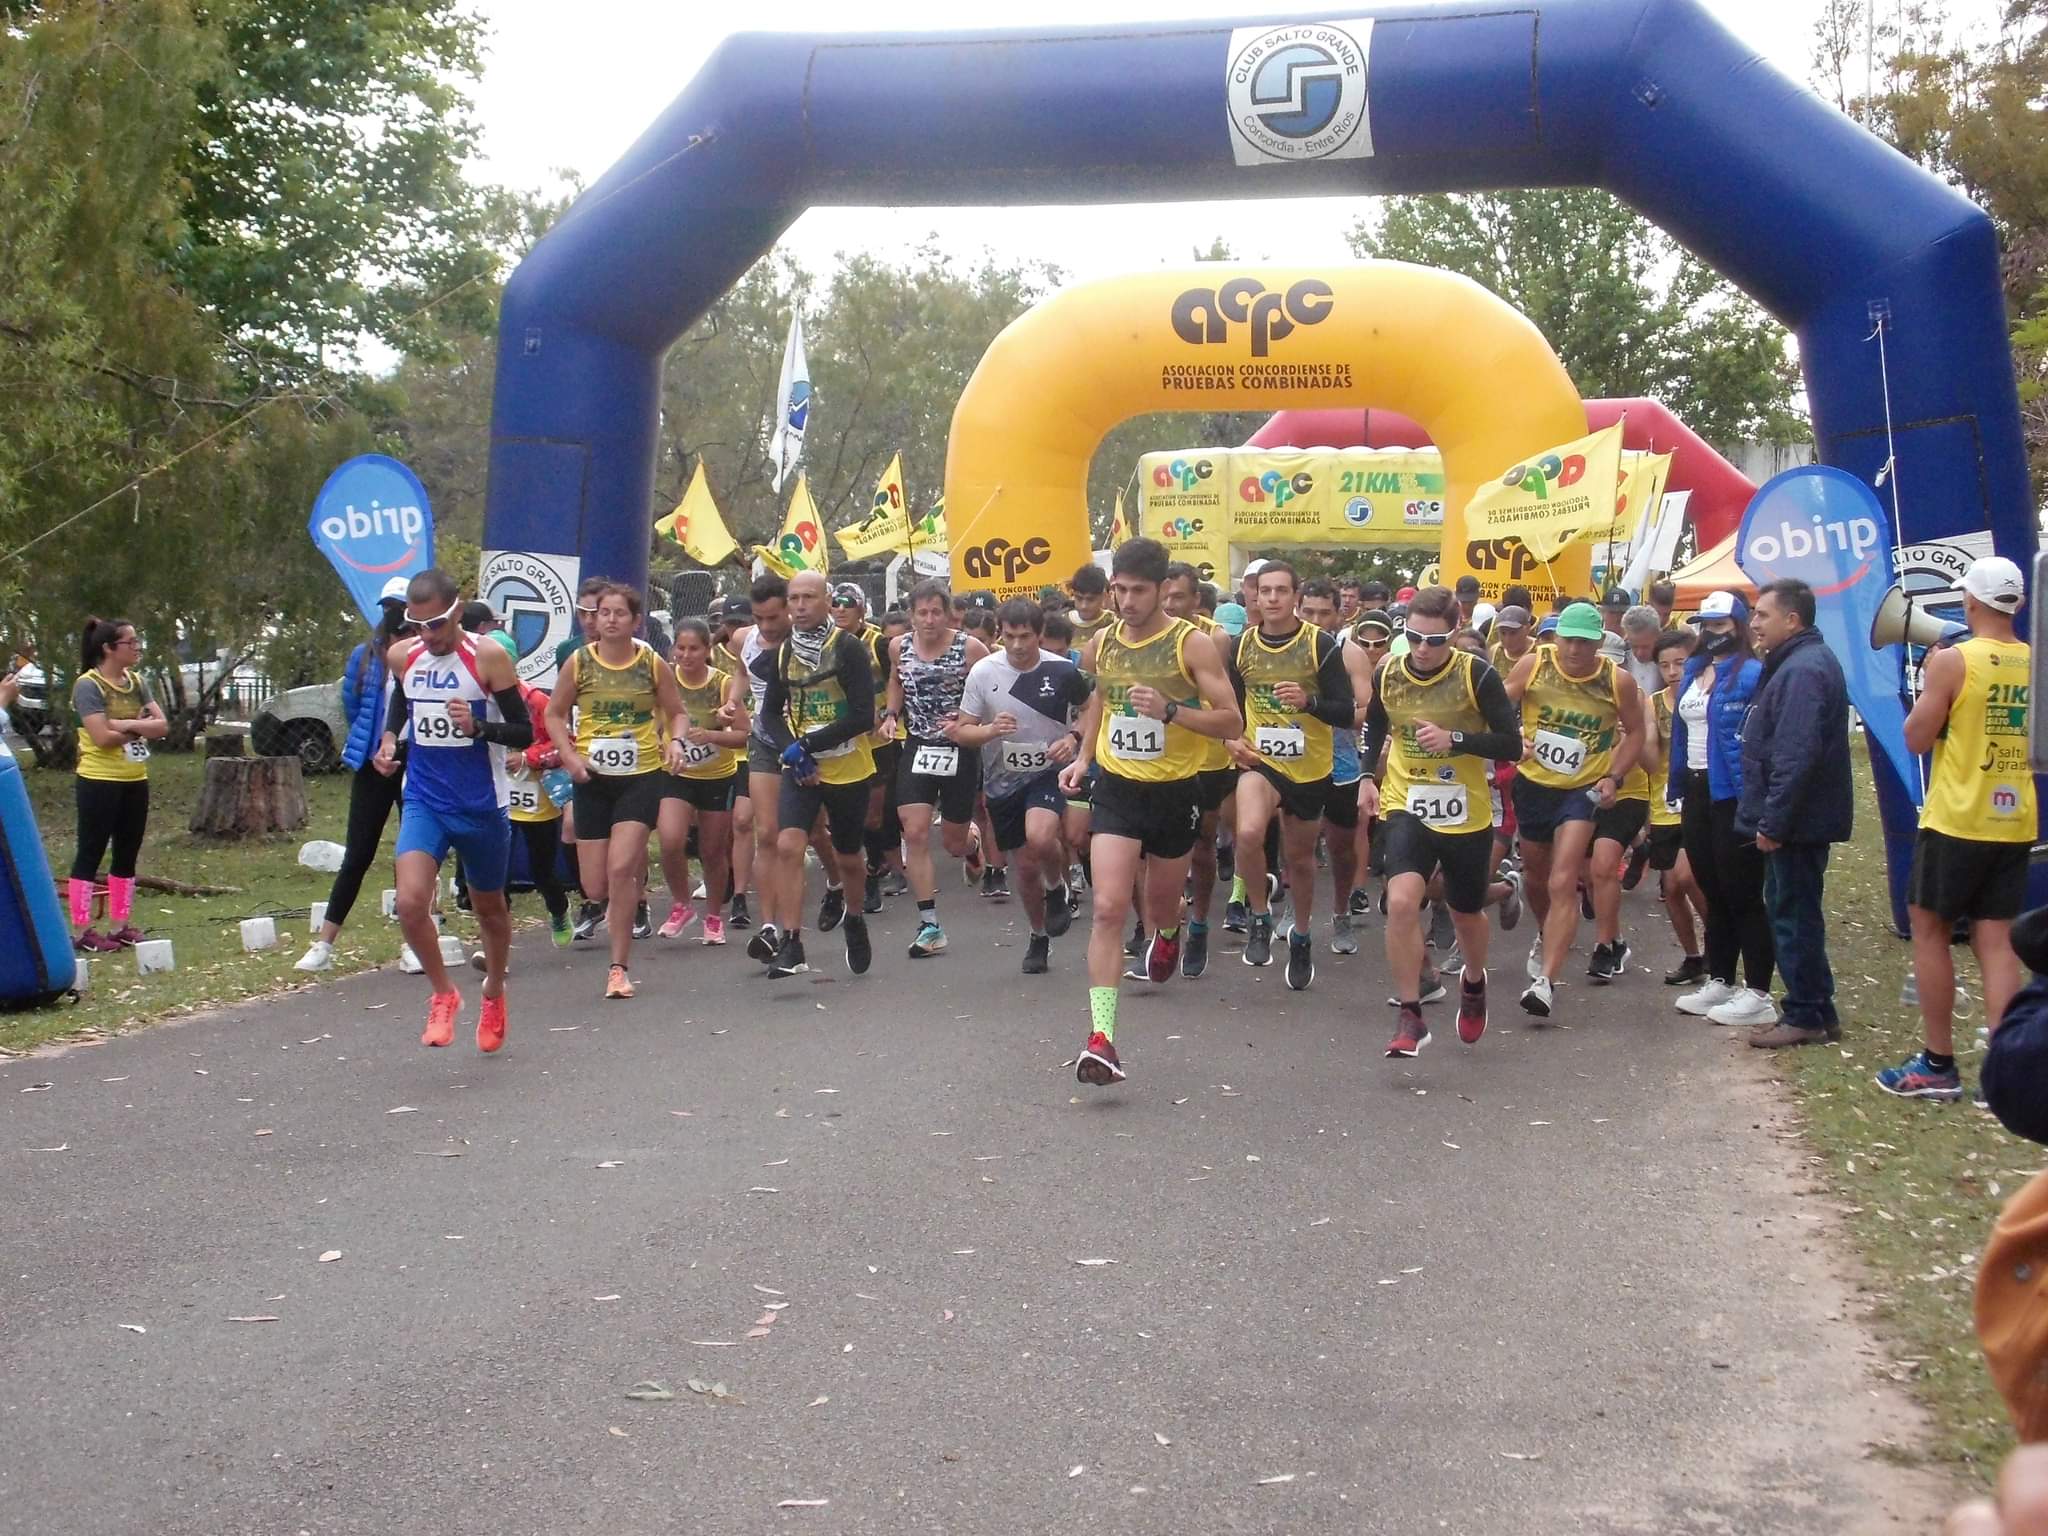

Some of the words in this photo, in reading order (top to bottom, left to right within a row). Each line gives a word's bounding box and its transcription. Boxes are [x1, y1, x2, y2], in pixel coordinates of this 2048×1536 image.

[1236, 47, 1263, 84] CLUB
[1265, 29, 1312, 49] SALTO
[1316, 31, 1359, 76] GRANDE
[1243, 115, 1294, 153] Concordia
[1304, 136, 1335, 153] Entre
[1162, 366, 1235, 376] ASOCIACION
[1239, 364, 1331, 376] CONCORDIENSE
[1336, 364, 1351, 375] DE
[1162, 377, 1235, 390] PRUEBAS
[1241, 375, 1353, 390] COMBINADAS
[1234, 517, 1268, 525] PRUEBAS
[1270, 516, 1321, 525] COMBINADAS
[489, 559, 523, 578] SALTO
[526, 564, 567, 616] GRANDE
[412, 670, 460, 689] FILA
[1538, 704, 1602, 731] 21KM
[1112, 728, 1162, 752] 411
[1260, 739, 1303, 757] 521
[592, 750, 635, 767] 493
[918, 754, 953, 771] 477
[1007, 751, 1046, 768] 433
[1536, 742, 1580, 769] 404
[1412, 799, 1463, 820] 510
